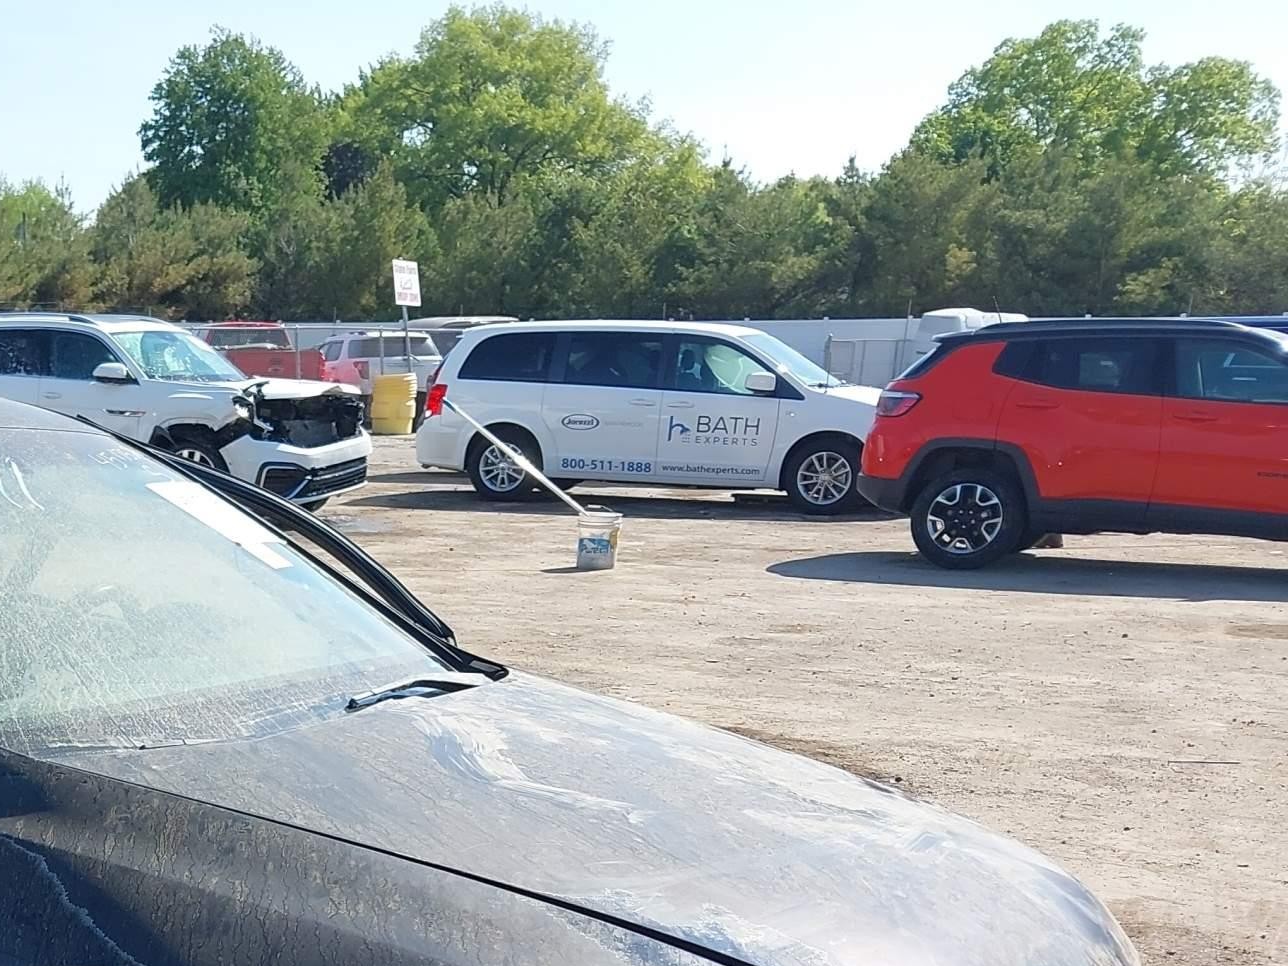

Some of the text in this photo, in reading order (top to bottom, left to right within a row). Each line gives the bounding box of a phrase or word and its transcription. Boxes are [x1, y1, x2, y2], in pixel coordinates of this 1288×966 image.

[696, 416, 760, 436] BATH
[694, 436, 758, 447] EXPERTS
[561, 458, 652, 473] 800-511-1888
[661, 464, 760, 475] www.bathexperts.com
